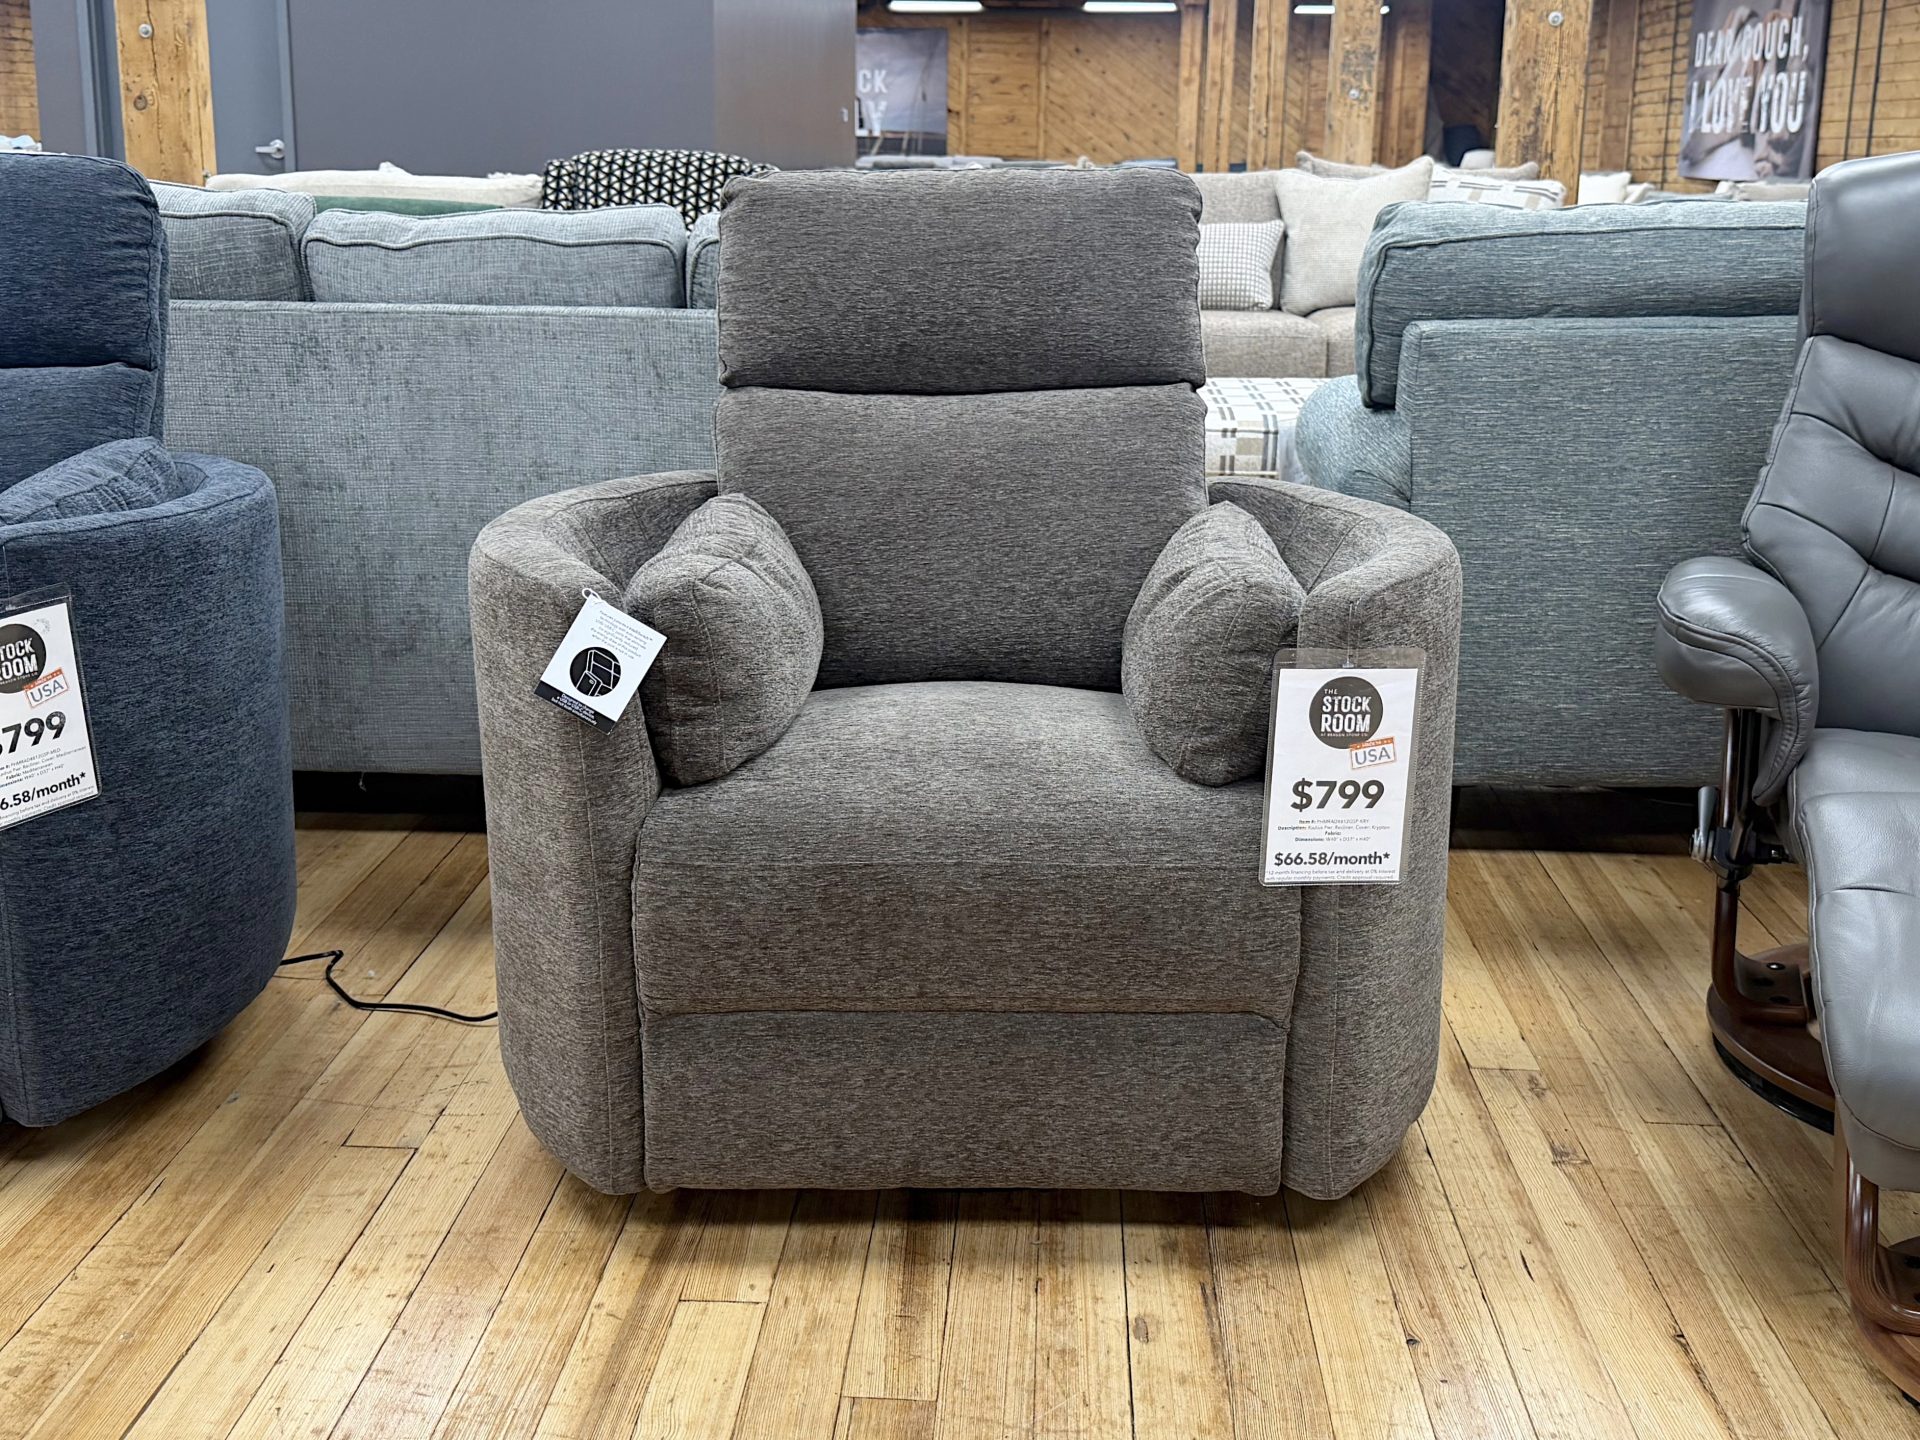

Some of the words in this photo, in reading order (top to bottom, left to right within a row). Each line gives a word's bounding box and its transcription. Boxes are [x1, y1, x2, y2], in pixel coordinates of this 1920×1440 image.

[1694, 28, 1737, 67] DEAR
[1742, 16, 1809, 62] COUCH,
[1688, 81, 1699, 133] I
[1700, 76, 1753, 134] LOVE
[1758, 71, 1808, 134] YOU
[0, 637, 35, 662] TOCK
[30, 679, 64, 703] USA
[1322, 696, 1372, 712] STOCK
[1320, 714, 1371, 732] ROOM
[1355, 747, 1391, 765] USA
[1290, 778, 1385, 812] $799
